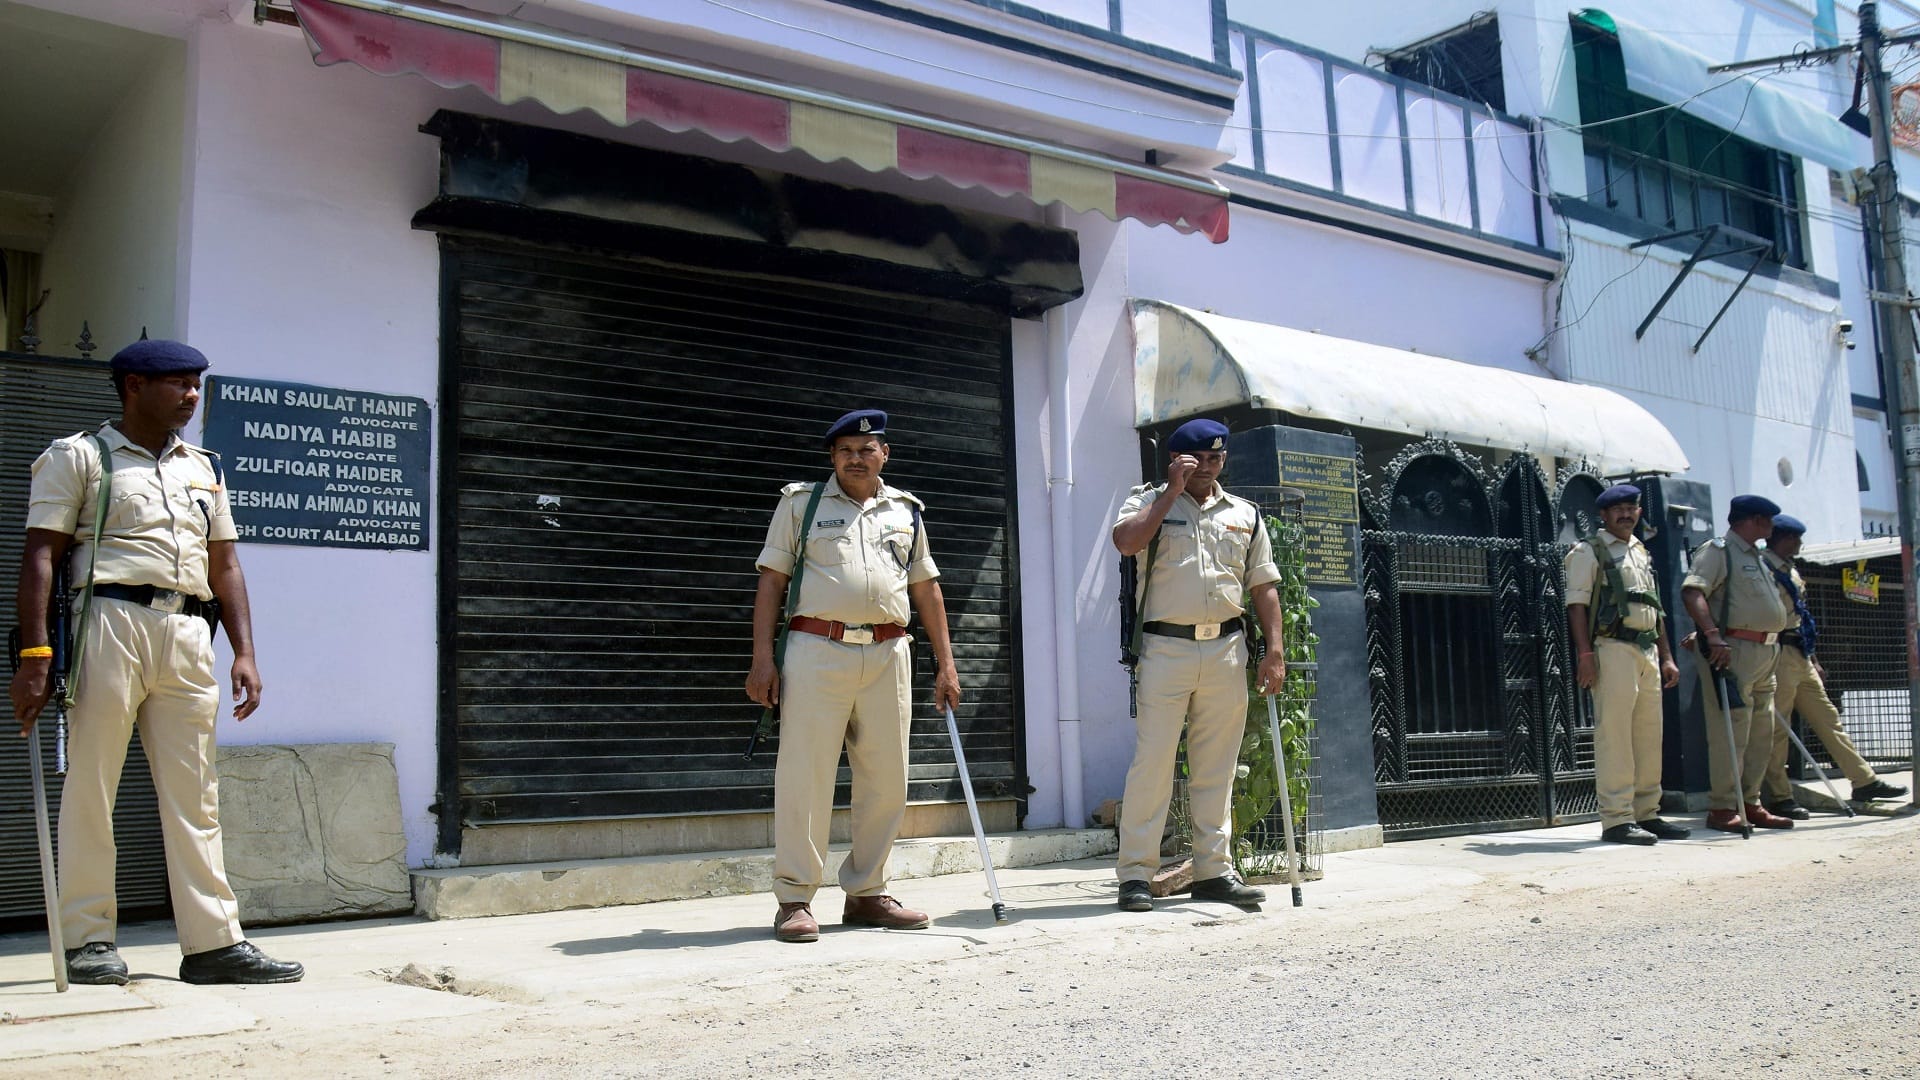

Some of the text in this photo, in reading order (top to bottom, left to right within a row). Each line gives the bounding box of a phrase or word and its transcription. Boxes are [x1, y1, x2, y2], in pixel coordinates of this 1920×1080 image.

[221, 384, 417, 417] KHAN SAULAT HANIF
[340, 416, 418, 431] ADVOCATE
[244, 421, 397, 449] NADIYA HABIB
[306, 448, 397, 463] ADVOCATE
[235, 457, 403, 483] ZULFIQAR HAIDER
[325, 483, 414, 497] ADVOCATE
[228, 490, 421, 517] EESHAN AHMAD KHAN
[338, 517, 421, 530] ADVOCATE
[236, 524, 420, 545] GH COURT ALLAHABAD
[1323, 536, 1348, 544] HANIF
[1325, 562, 1350, 570] HANIF
